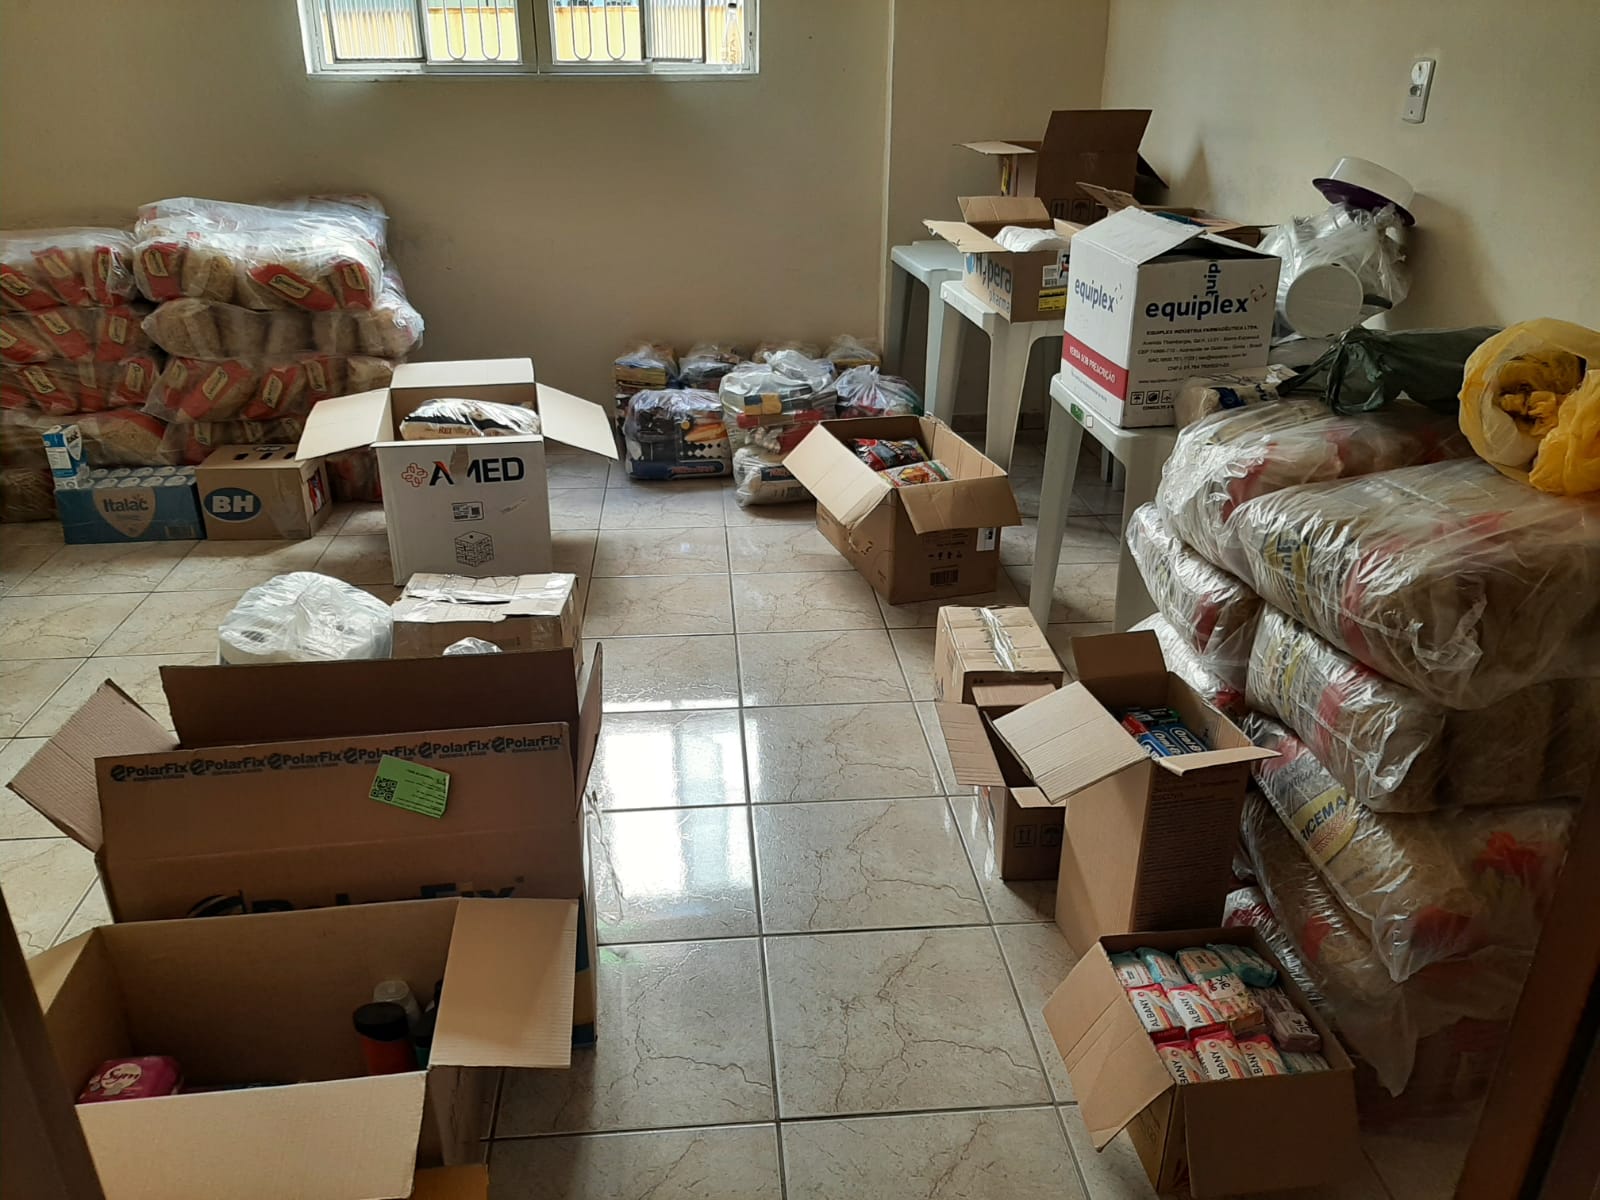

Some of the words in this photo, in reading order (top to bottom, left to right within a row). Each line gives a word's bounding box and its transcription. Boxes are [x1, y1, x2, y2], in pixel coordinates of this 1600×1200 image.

[1075, 279, 1115, 312] equiplex
[1145, 294, 1249, 322] equiplex
[103, 497, 149, 512] Italac
[212, 495, 254, 513] BH
[126, 762, 188, 778] PolarFix
[206, 756, 266, 771] PolarFix
[283, 751, 343, 765] PolarFix
[358, 745, 416, 760] PolarFix
[432, 740, 491, 754] PolarFix
[506, 735, 562, 749] PolarFix
[1139, 999, 1161, 1027] ALBANY
[1181, 998, 1203, 1023] ALBANY
[102, 1067, 140, 1085] Sym
[1172, 1060, 1189, 1085] BANY
[1245, 1053, 1265, 1077] BANY
